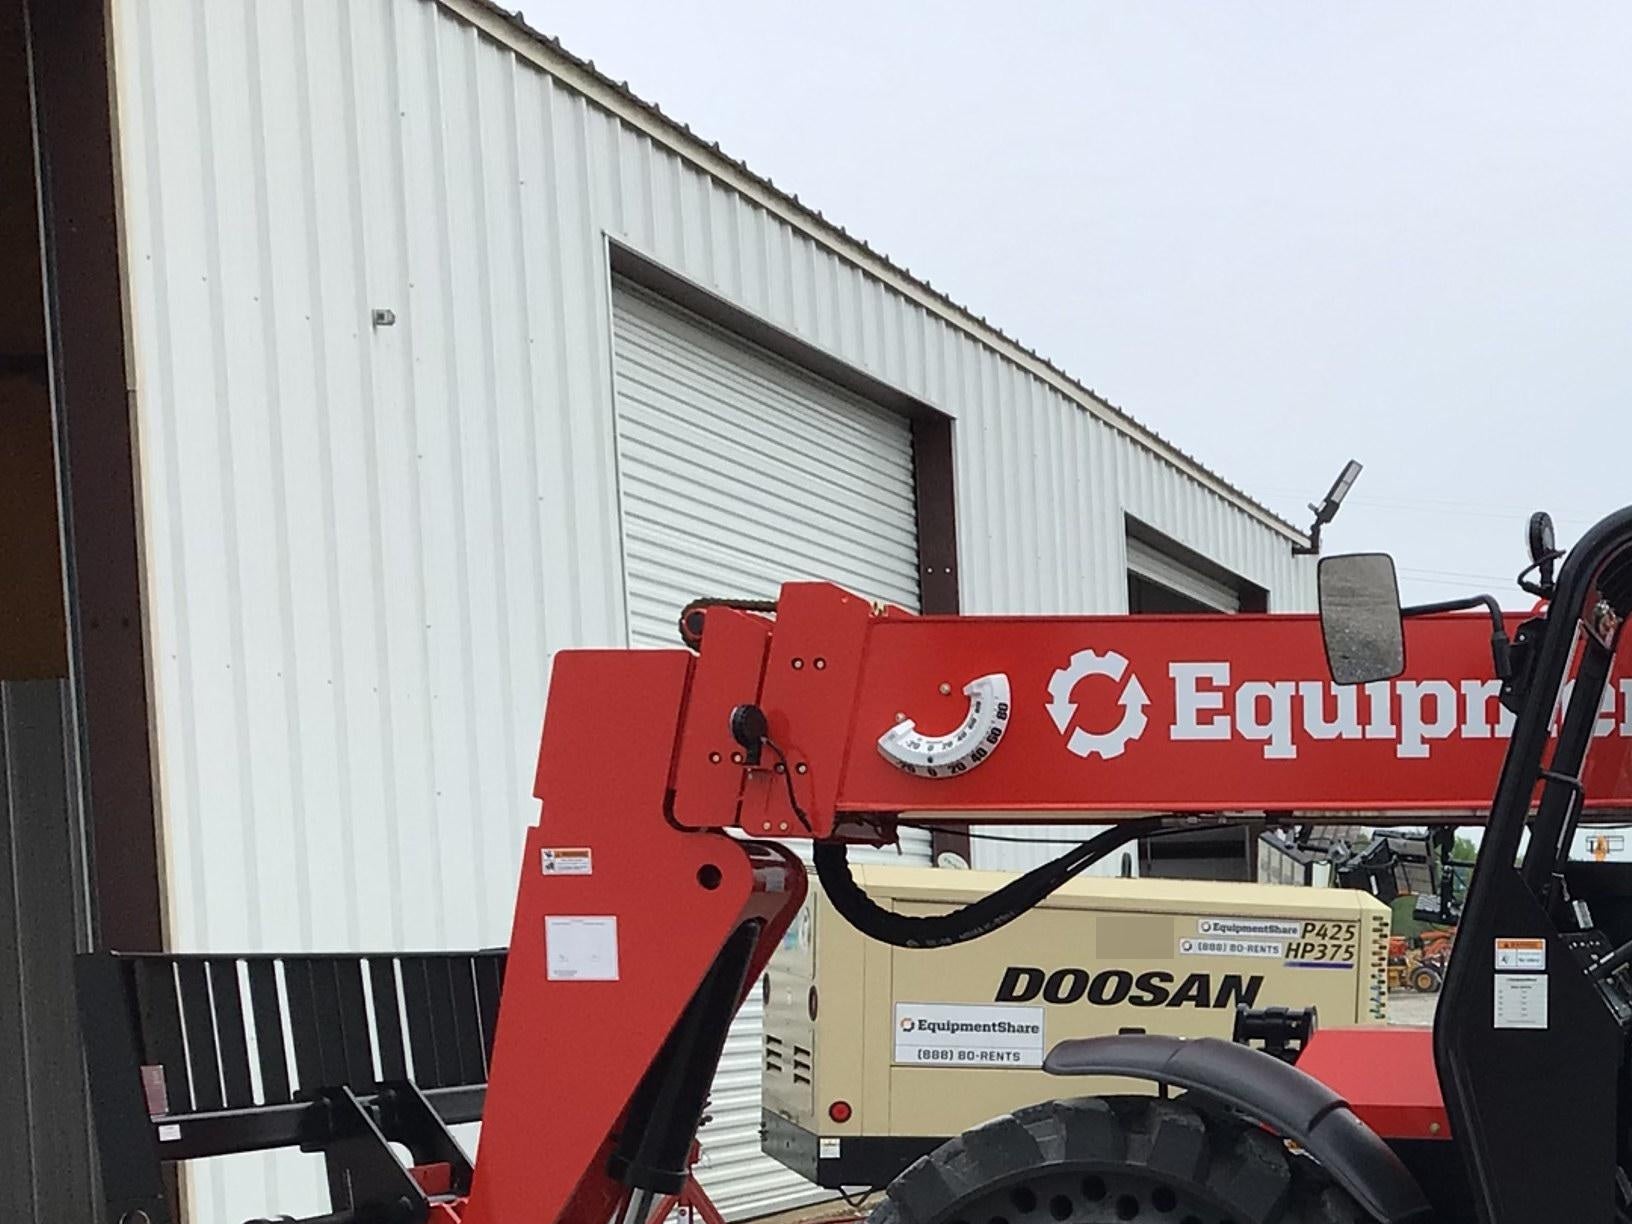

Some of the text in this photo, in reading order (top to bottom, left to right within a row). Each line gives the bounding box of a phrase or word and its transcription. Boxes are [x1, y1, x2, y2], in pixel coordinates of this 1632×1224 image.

[1213, 923, 1298, 934] EquipmentShare
[1301, 922, 1355, 941] P425
[1285, 942, 1354, 961] HP375
[995, 966, 1265, 1009] DOOSAN
[917, 1019, 1040, 1034] EquipmentShare
[917, 1049, 1021, 1062] (888) 80-RENTS
